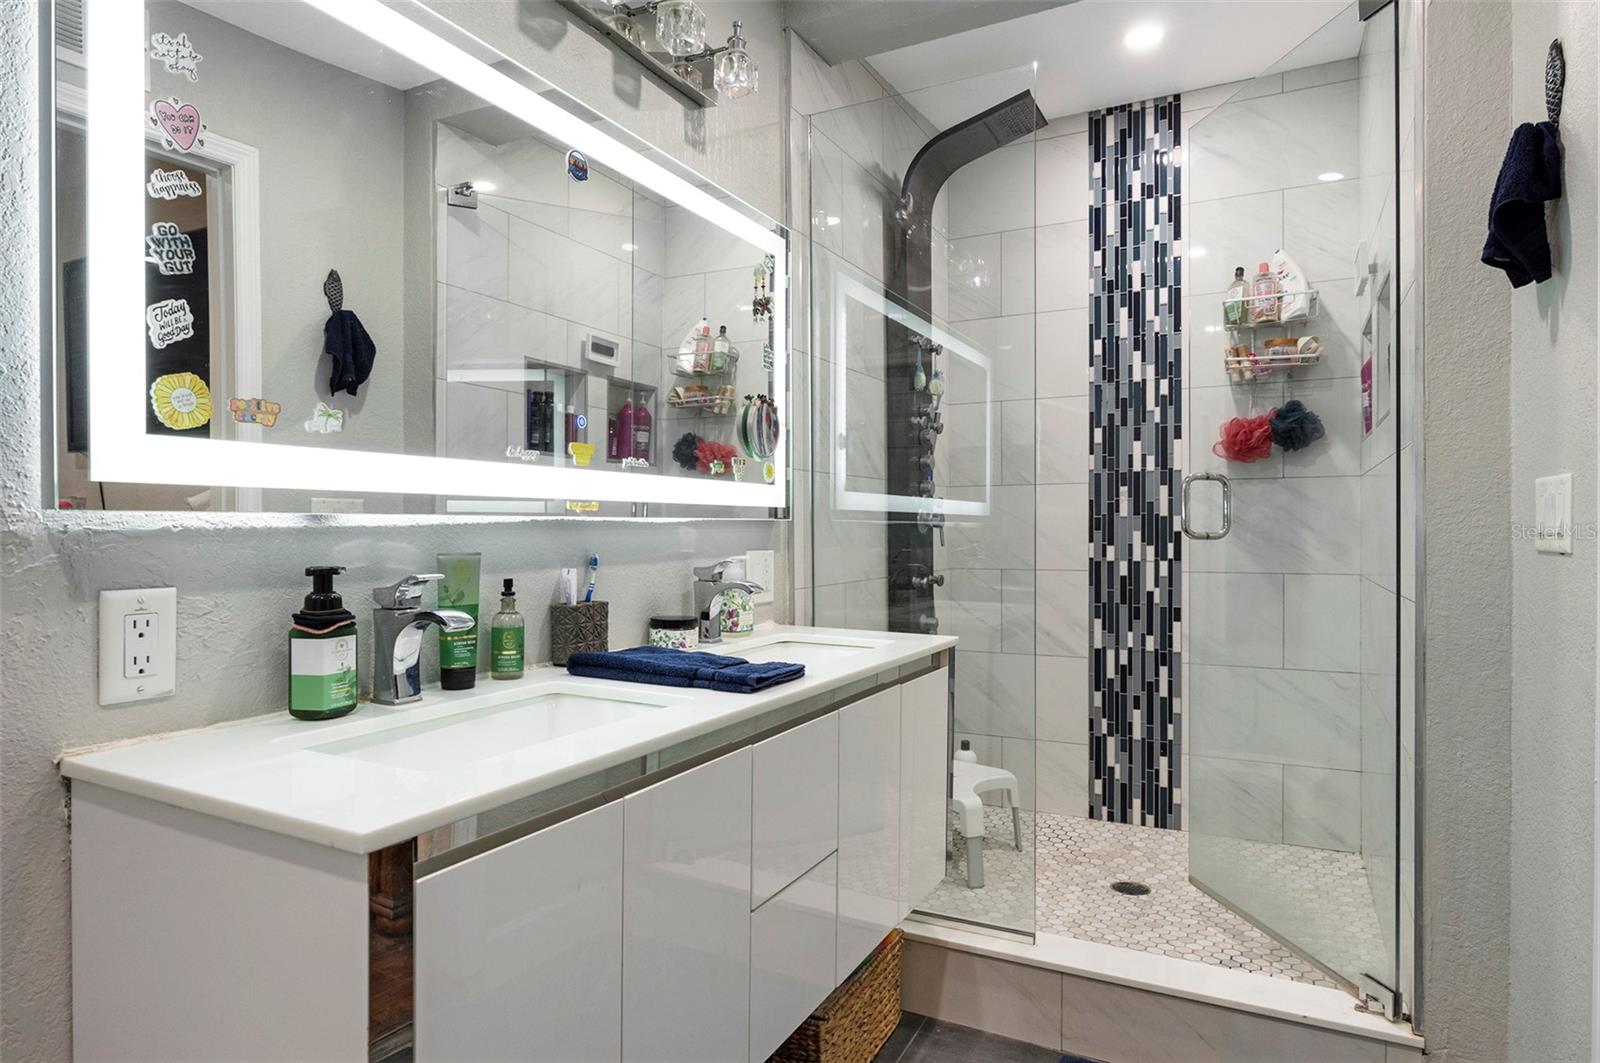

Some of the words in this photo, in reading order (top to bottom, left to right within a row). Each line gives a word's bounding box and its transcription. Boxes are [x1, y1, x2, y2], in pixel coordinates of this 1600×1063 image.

[157, 224, 177, 236] GO
[150, 236, 191, 249] WITH
[153, 249, 193, 261] YOUR
[164, 261, 191, 272] GUT
[152, 301, 187, 322] Today
